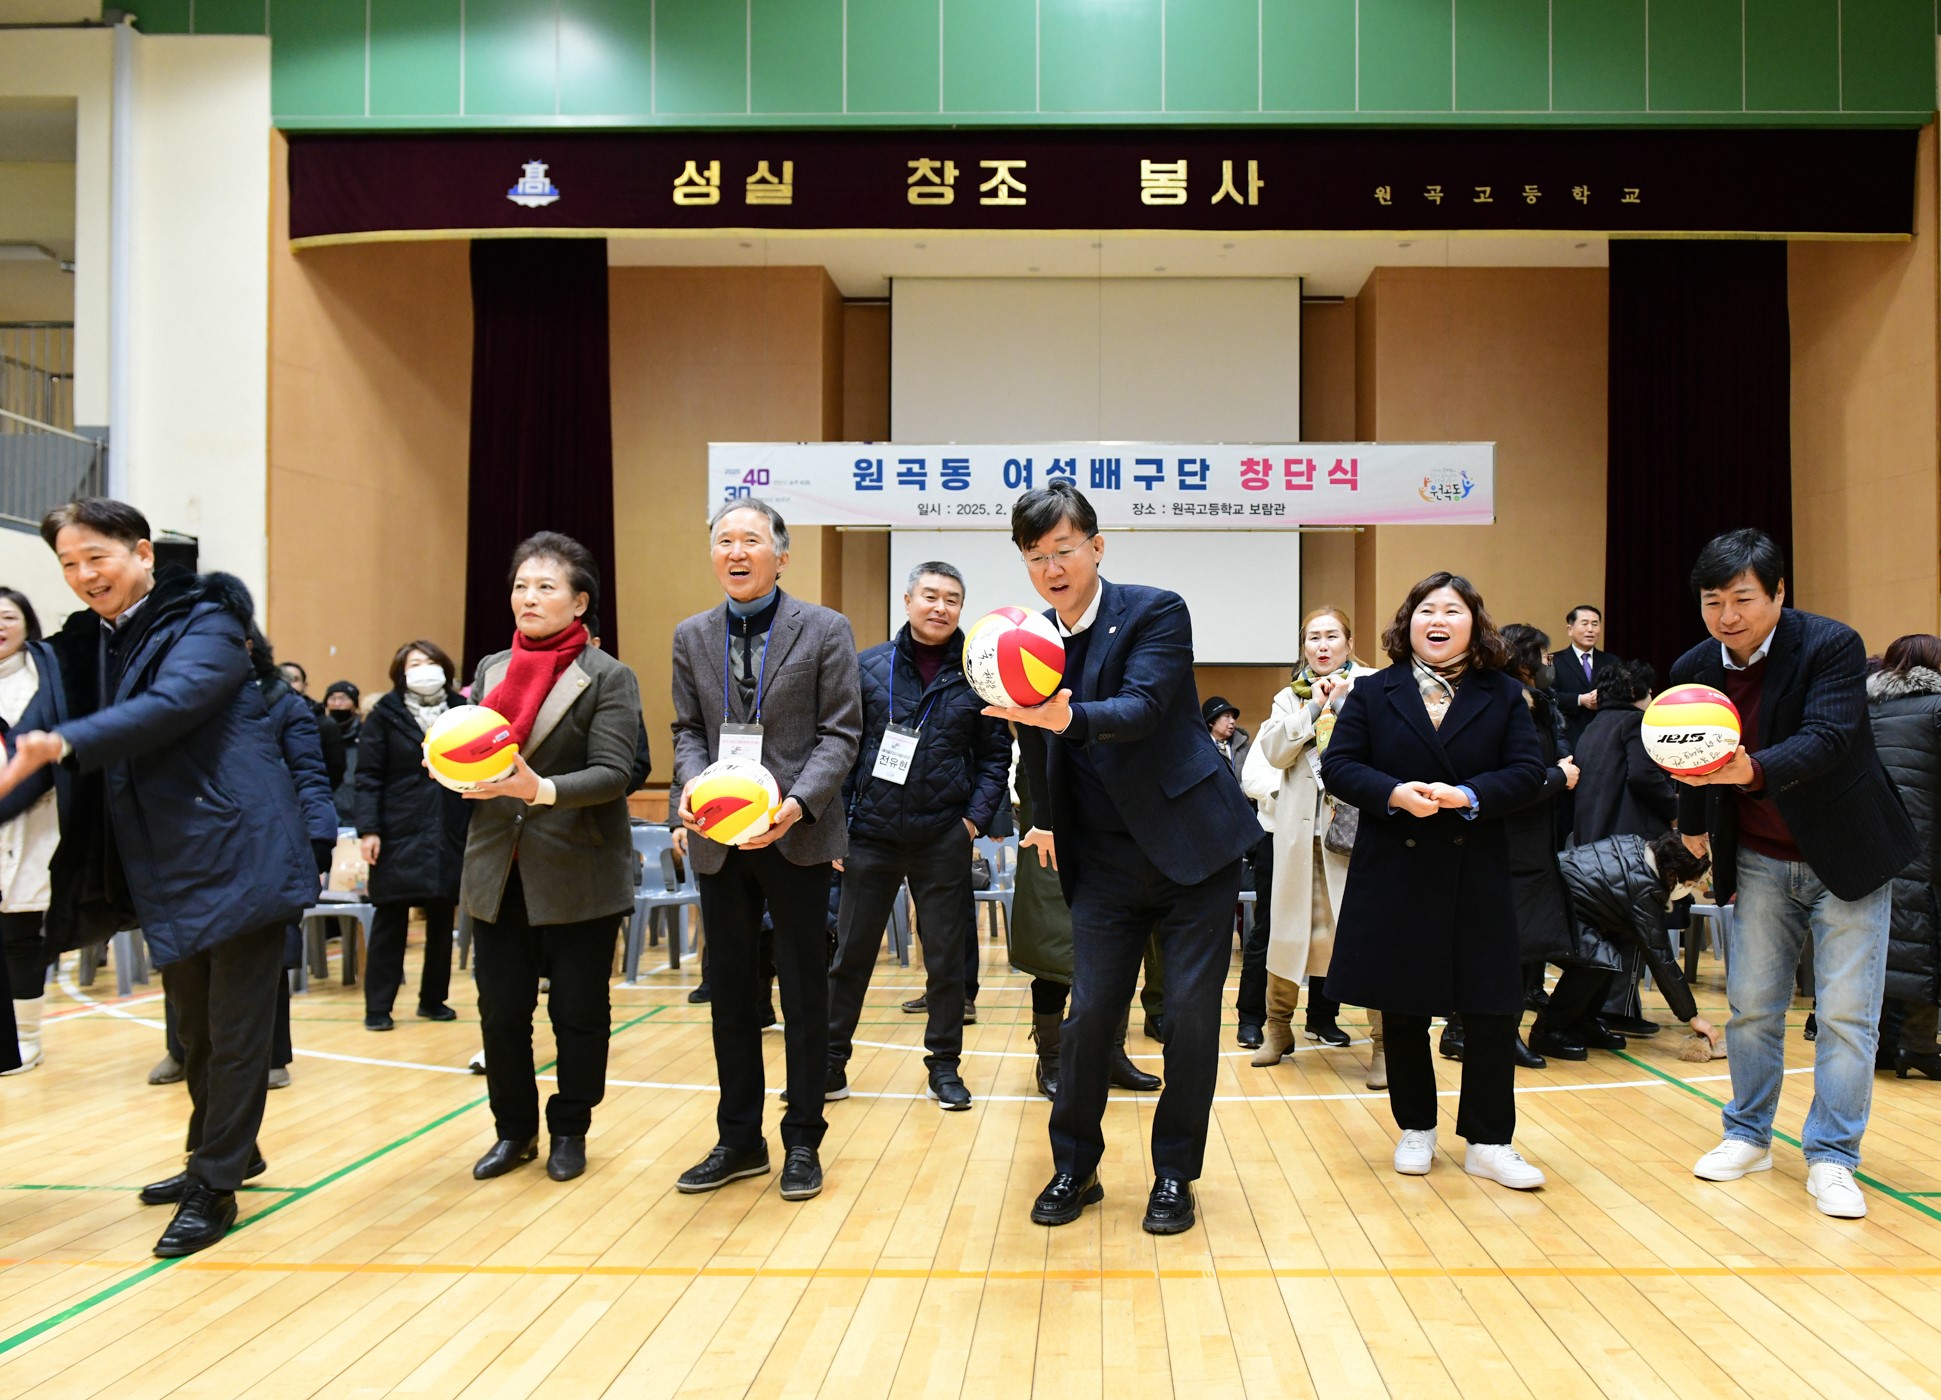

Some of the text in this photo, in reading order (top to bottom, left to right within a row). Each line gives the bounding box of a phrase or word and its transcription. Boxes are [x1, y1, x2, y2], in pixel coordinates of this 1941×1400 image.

[672, 157, 1265, 206] 성실 창조 봉사
[1374, 185, 1641, 205] 원곡고등학교
[743, 468, 770, 487] 40
[853, 457, 1359, 492] 원곡동 여성배구단 창단식
[724, 485, 751, 503] 30
[1429, 483, 1462, 502] 원곡동
[917, 503, 941, 516] 일시
[956, 503, 991, 516] 2025.
[1132, 502, 1157, 516] 장소
[1171, 502, 1245, 516] 원곡고등학교
[1249, 502, 1286, 516] 보람관
[879, 754, 908, 771] 전유현
